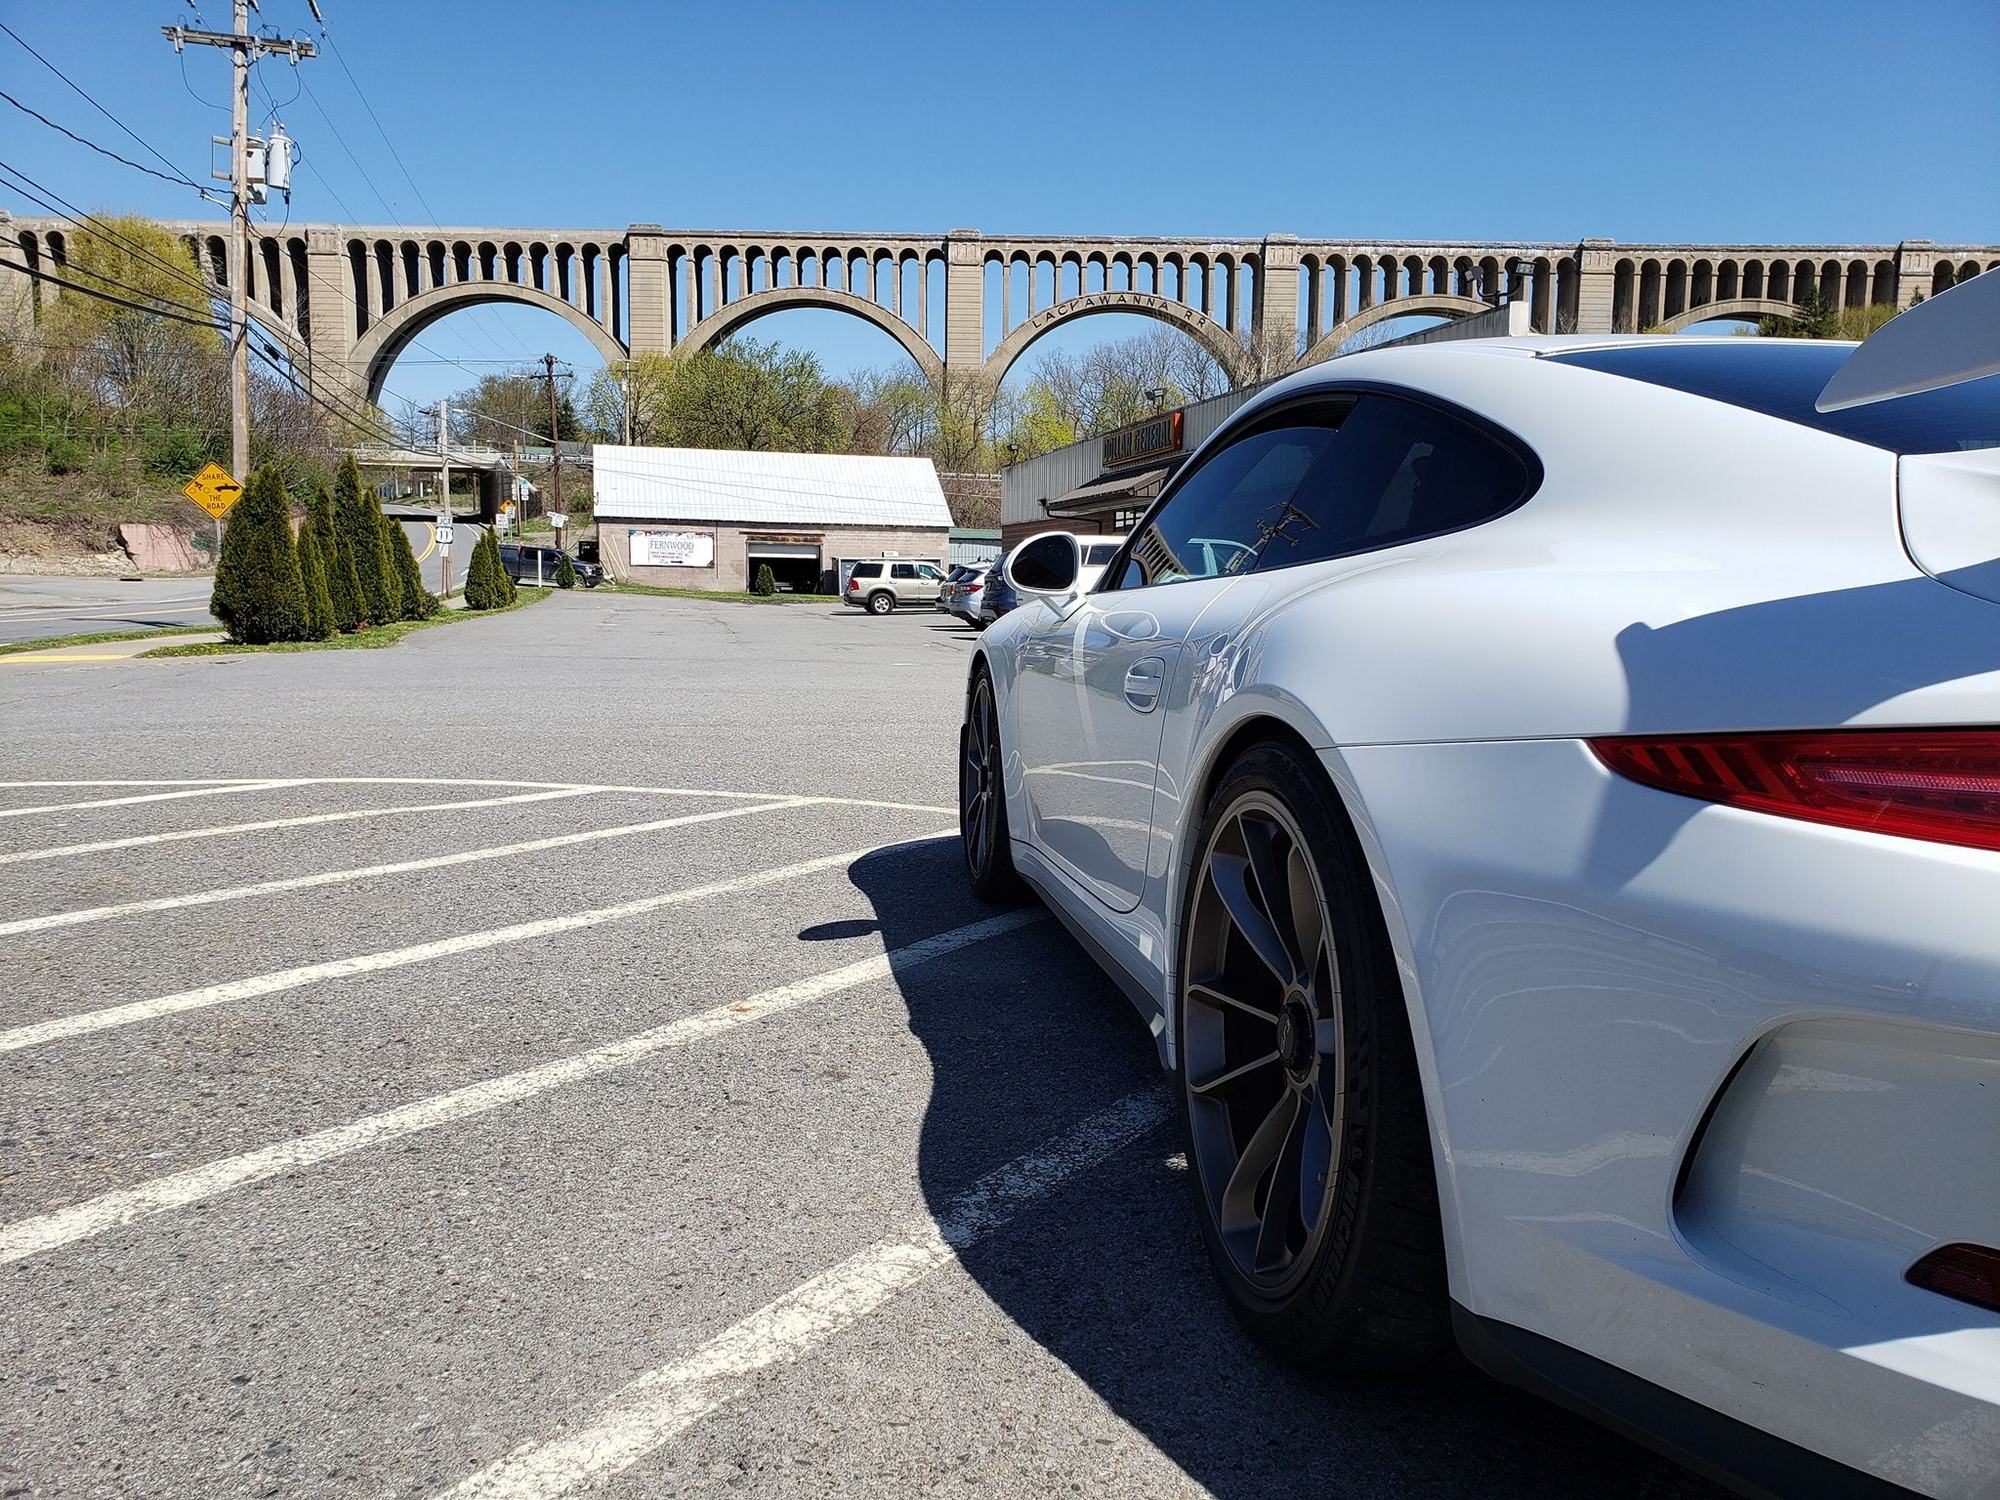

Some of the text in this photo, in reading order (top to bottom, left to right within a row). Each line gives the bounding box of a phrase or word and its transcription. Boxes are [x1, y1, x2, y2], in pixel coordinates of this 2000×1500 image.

[1032, 294, 1206, 329] LACKAWANNA RR
[1103, 419, 1171, 462] DOLLAR GENERAL
[650, 540, 694, 551] FERNWOOD
[1312, 1168, 1361, 1314] MICHELIN
